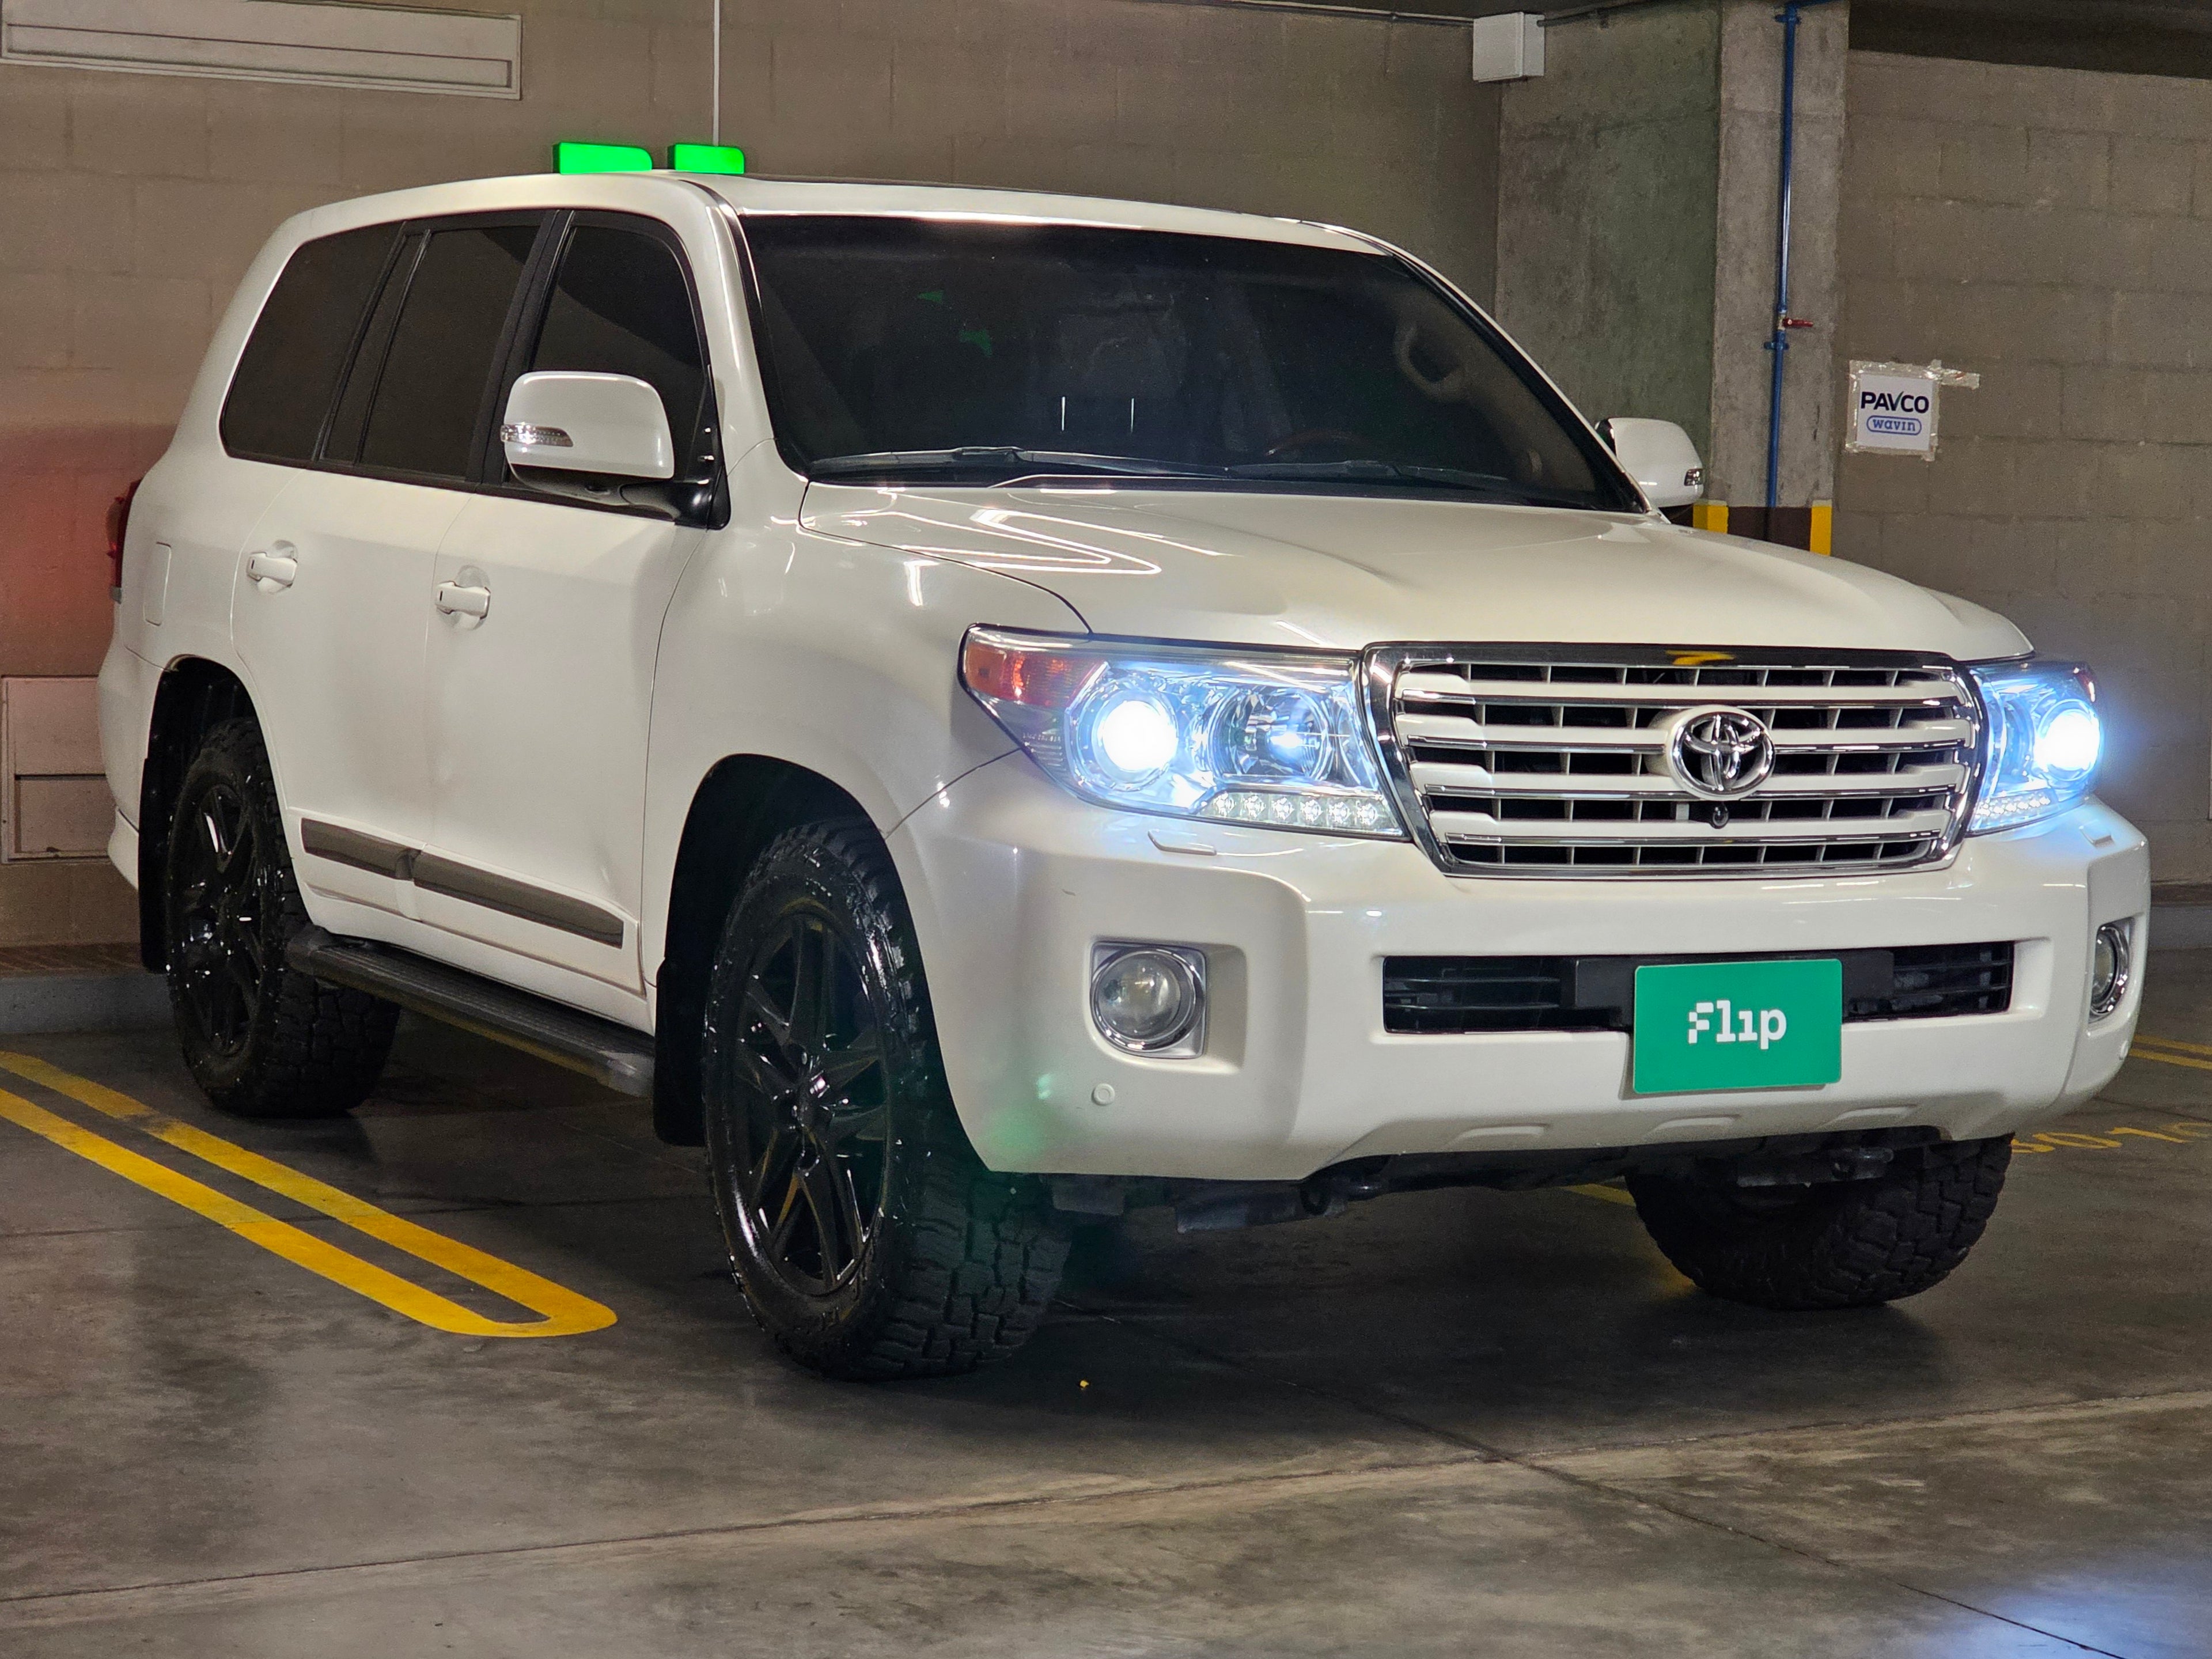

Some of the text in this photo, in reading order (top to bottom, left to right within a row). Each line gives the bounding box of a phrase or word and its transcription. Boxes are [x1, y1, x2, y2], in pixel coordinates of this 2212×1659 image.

[1861, 391, 1929, 414] PAVCO
[1872, 419, 1915, 431] wavin
[1688, 1000, 1787, 1050] Flip
